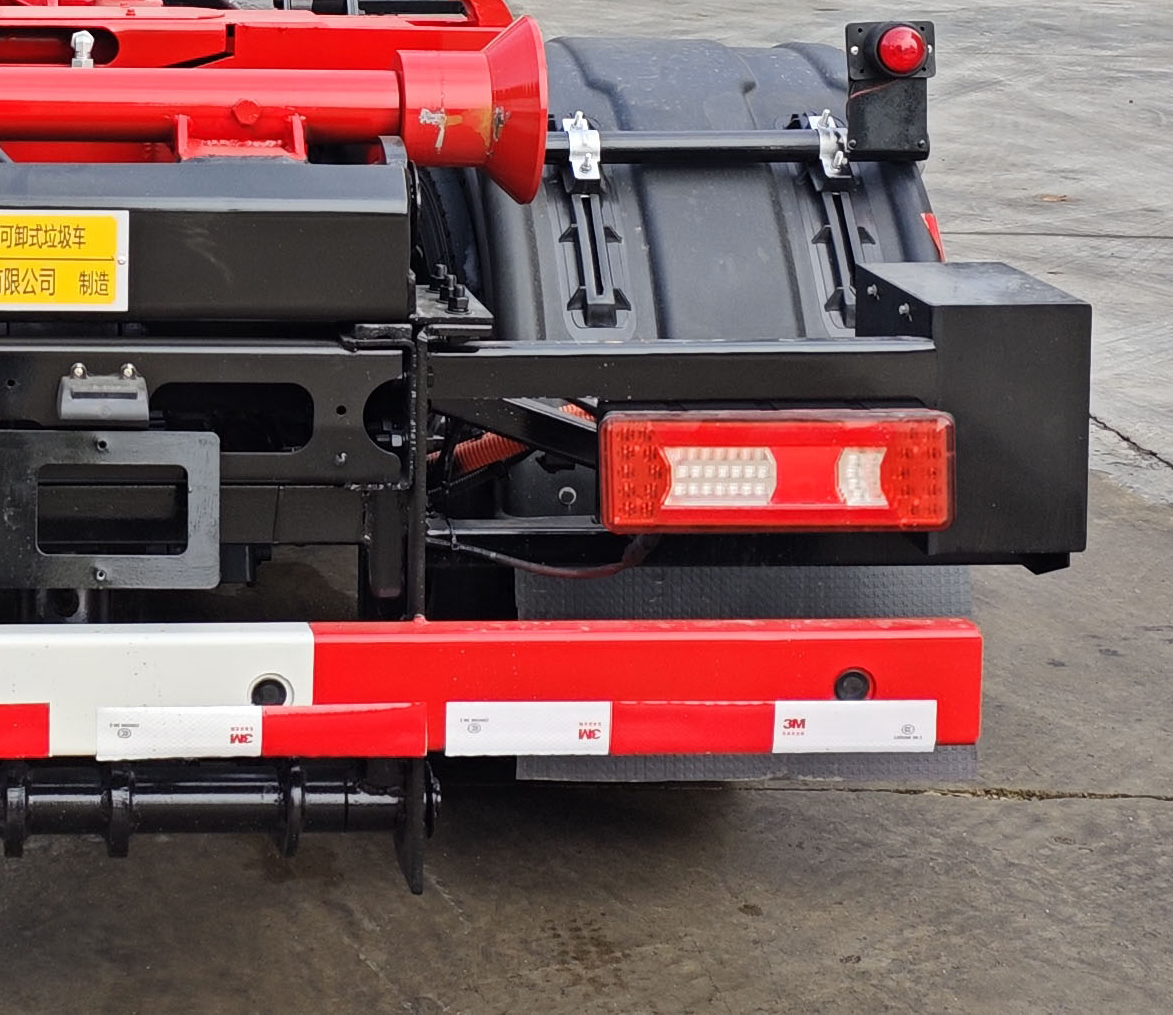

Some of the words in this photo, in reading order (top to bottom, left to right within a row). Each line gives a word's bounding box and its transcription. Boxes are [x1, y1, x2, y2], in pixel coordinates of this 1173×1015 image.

[79, 270, 110, 296] 制造
[783, 718, 806, 729] 3M
[230, 733, 253, 744] 3M
[578, 728, 601, 739] 3M
